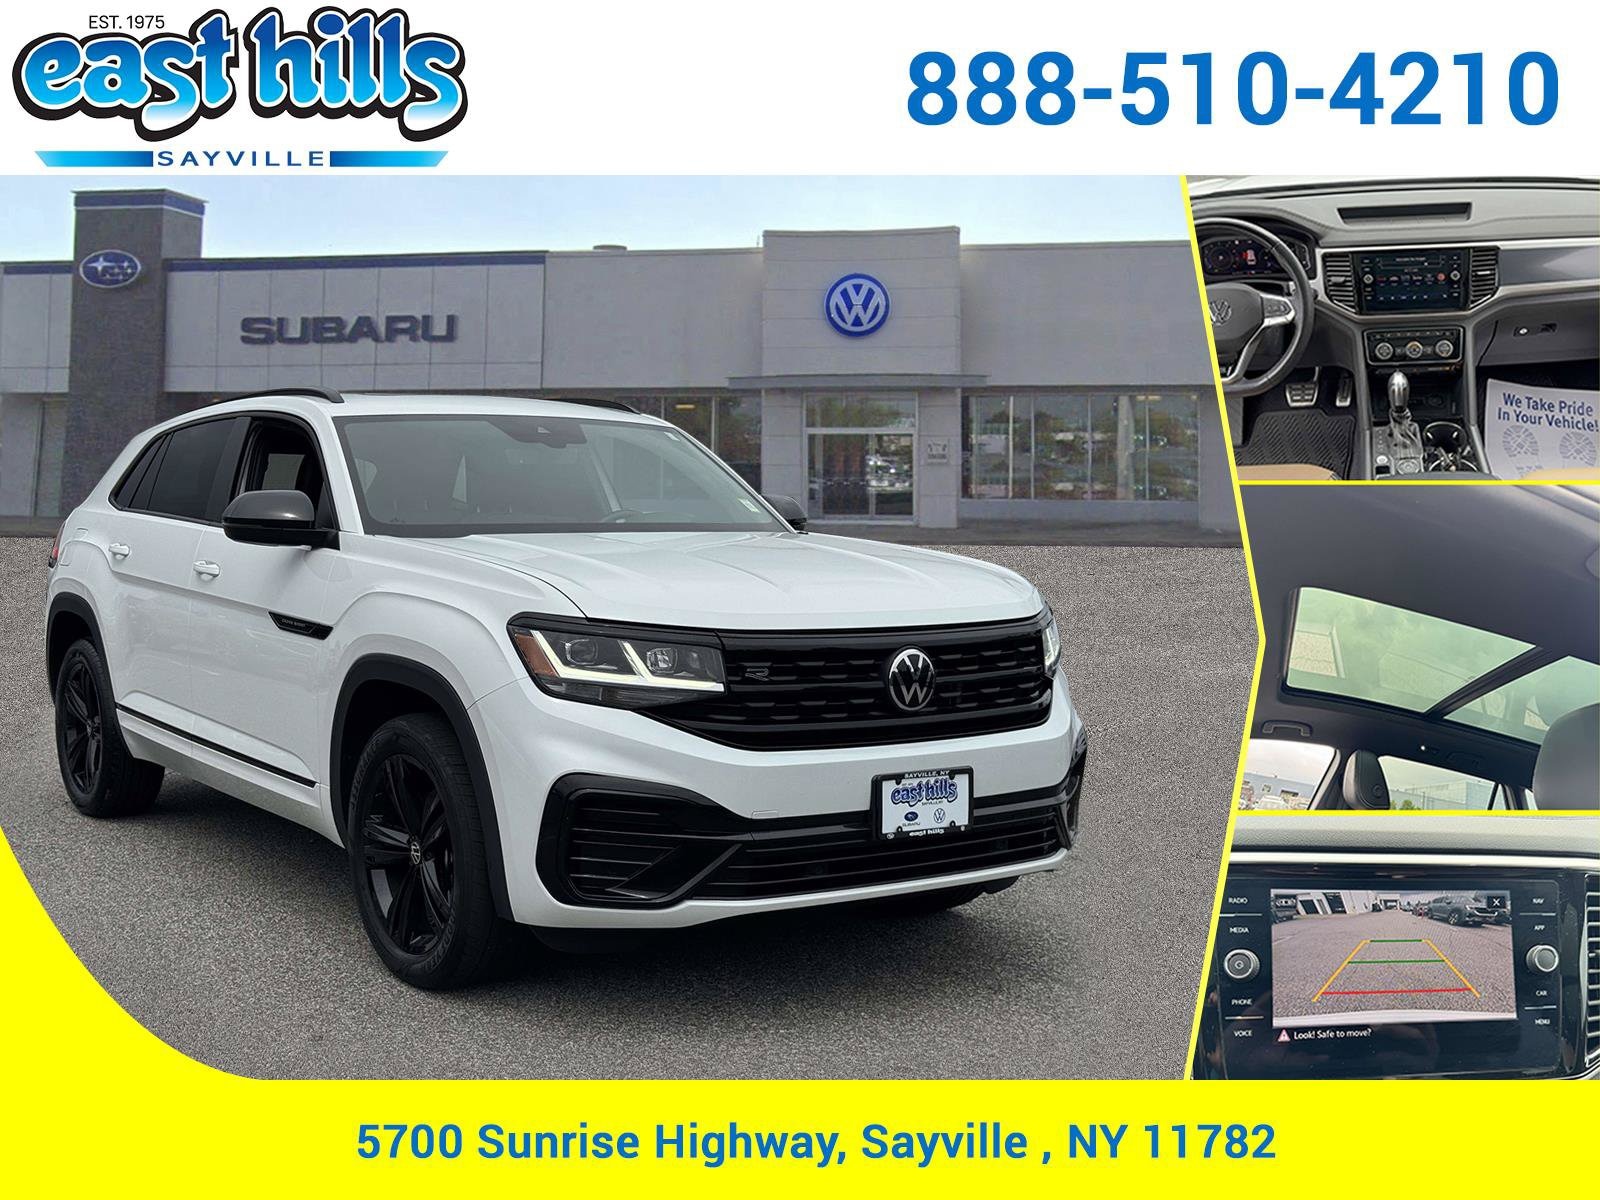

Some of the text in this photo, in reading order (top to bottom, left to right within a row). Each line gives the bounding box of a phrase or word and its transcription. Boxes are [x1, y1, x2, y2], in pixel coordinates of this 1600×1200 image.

[240, 314, 457, 345] SUBARU
[1502, 392, 1593, 417] We Take Pride
[1497, 407, 1599, 432] In Your Vehicle!
[891, 777, 958, 807] east hills
[1294, 1028, 1372, 1040] Look! Safe to move?
